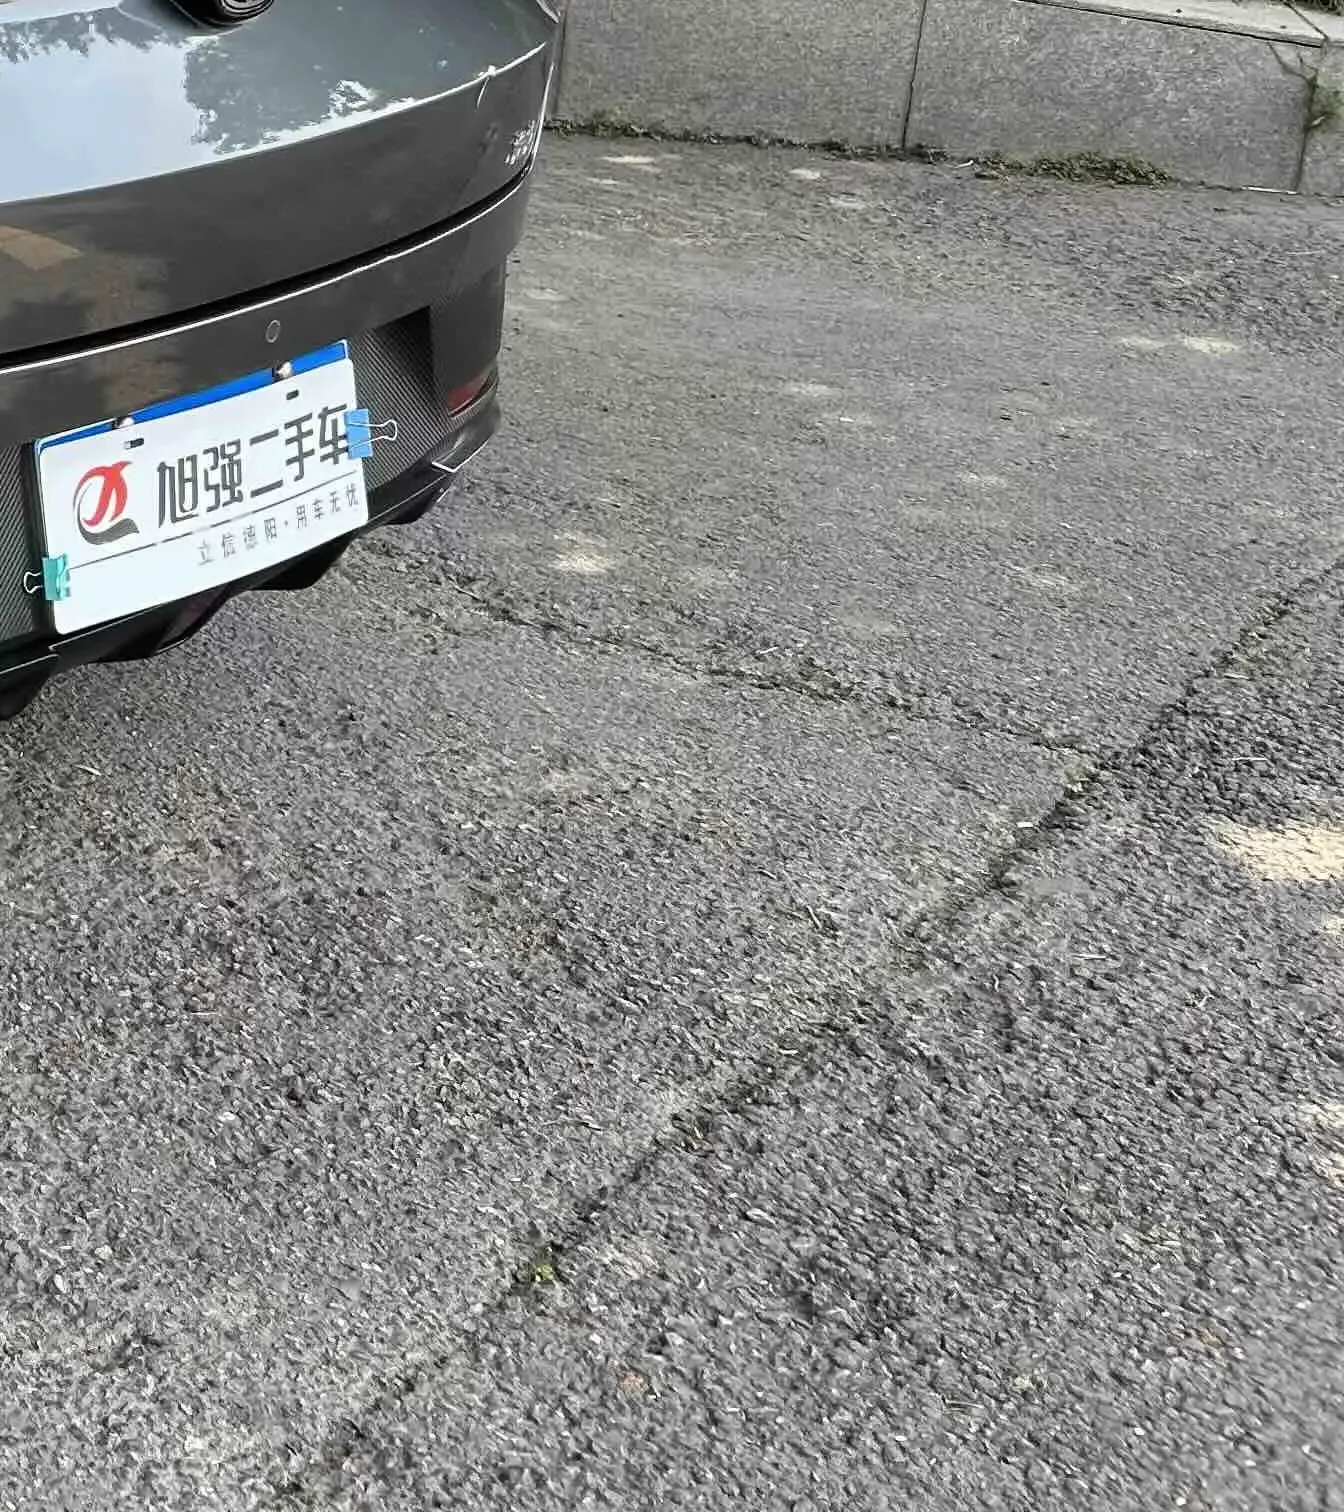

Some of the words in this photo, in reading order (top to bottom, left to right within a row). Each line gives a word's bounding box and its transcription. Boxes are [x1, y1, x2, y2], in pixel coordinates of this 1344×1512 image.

[156, 403, 352, 529] 旭强二手车
